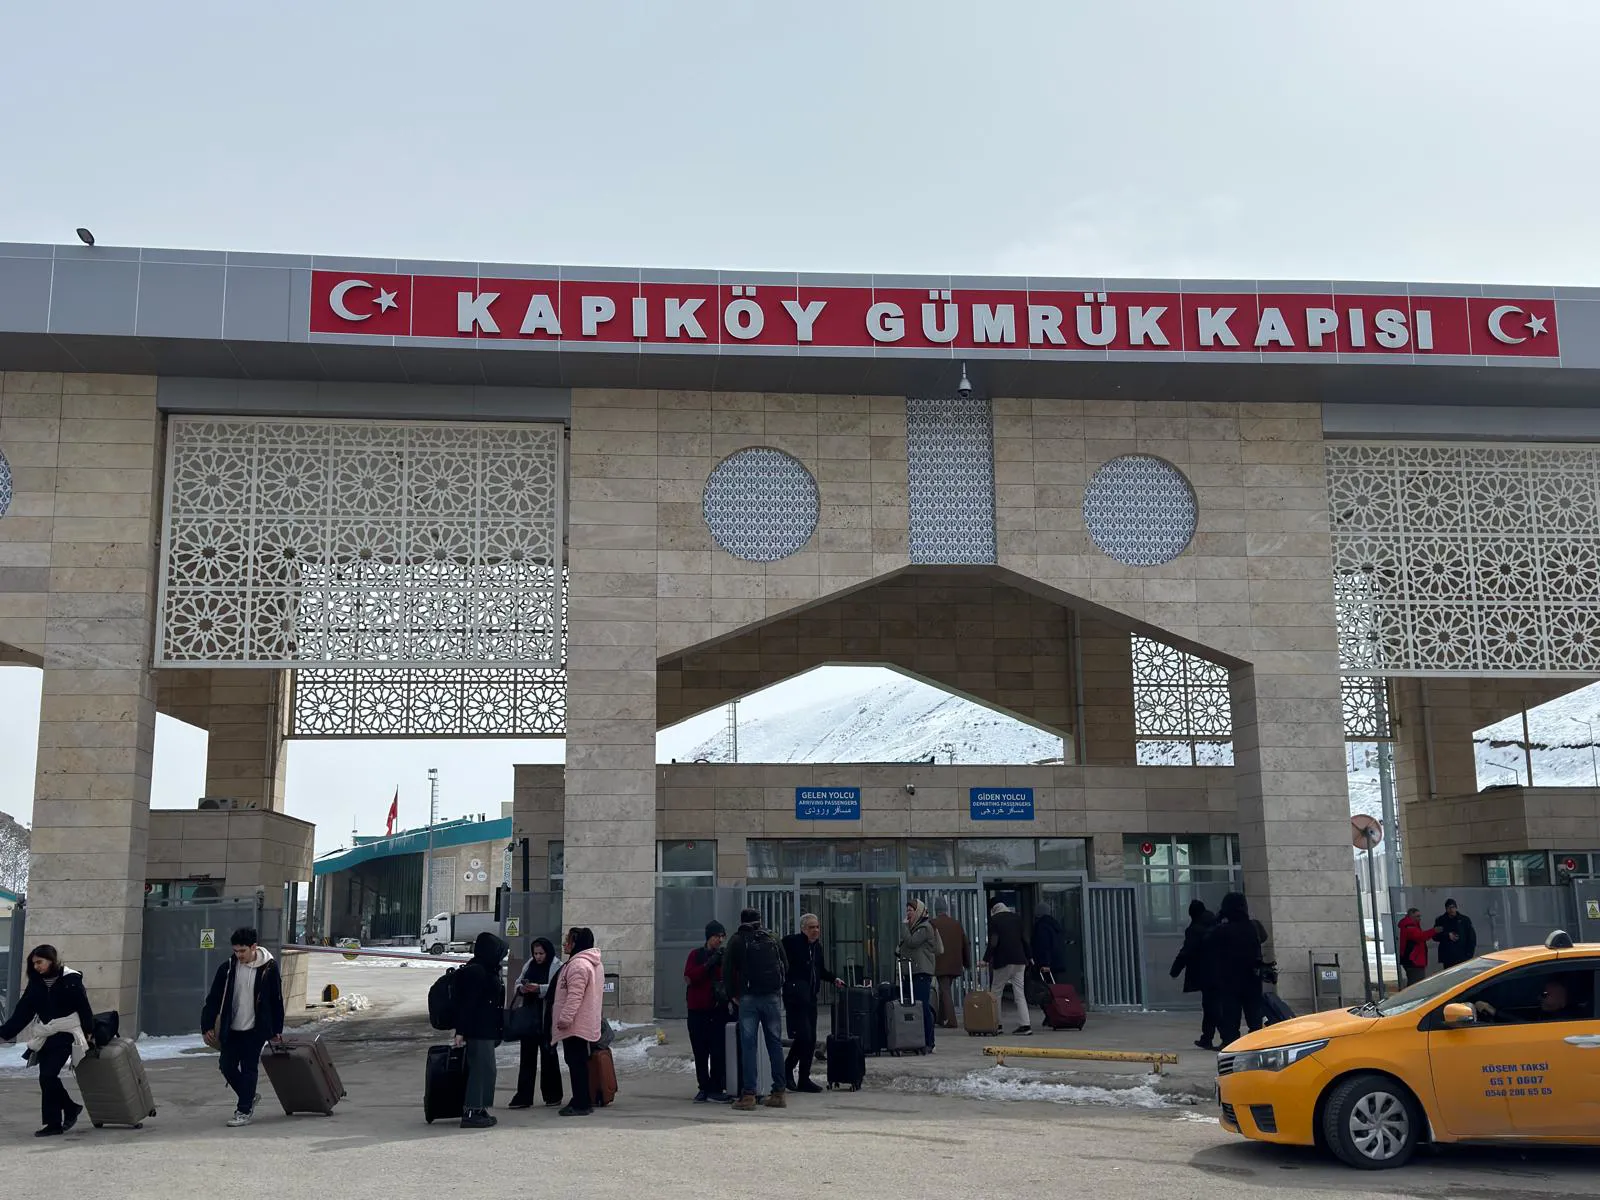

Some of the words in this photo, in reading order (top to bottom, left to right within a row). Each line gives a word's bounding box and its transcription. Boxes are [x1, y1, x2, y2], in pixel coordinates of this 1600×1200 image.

[457, 286, 827, 342] KAPIKÖY
[866, 290, 1170, 346] GÜMRÜK
[1197, 307, 1435, 350] KAPISI
[801, 791, 827, 799] GELEN
[828, 791, 855, 799] YOLCU
[977, 792, 1000, 801] GİDEN
[1001, 793, 1026, 801] YOLCU
[1507, 1076, 1512, 1085] T
